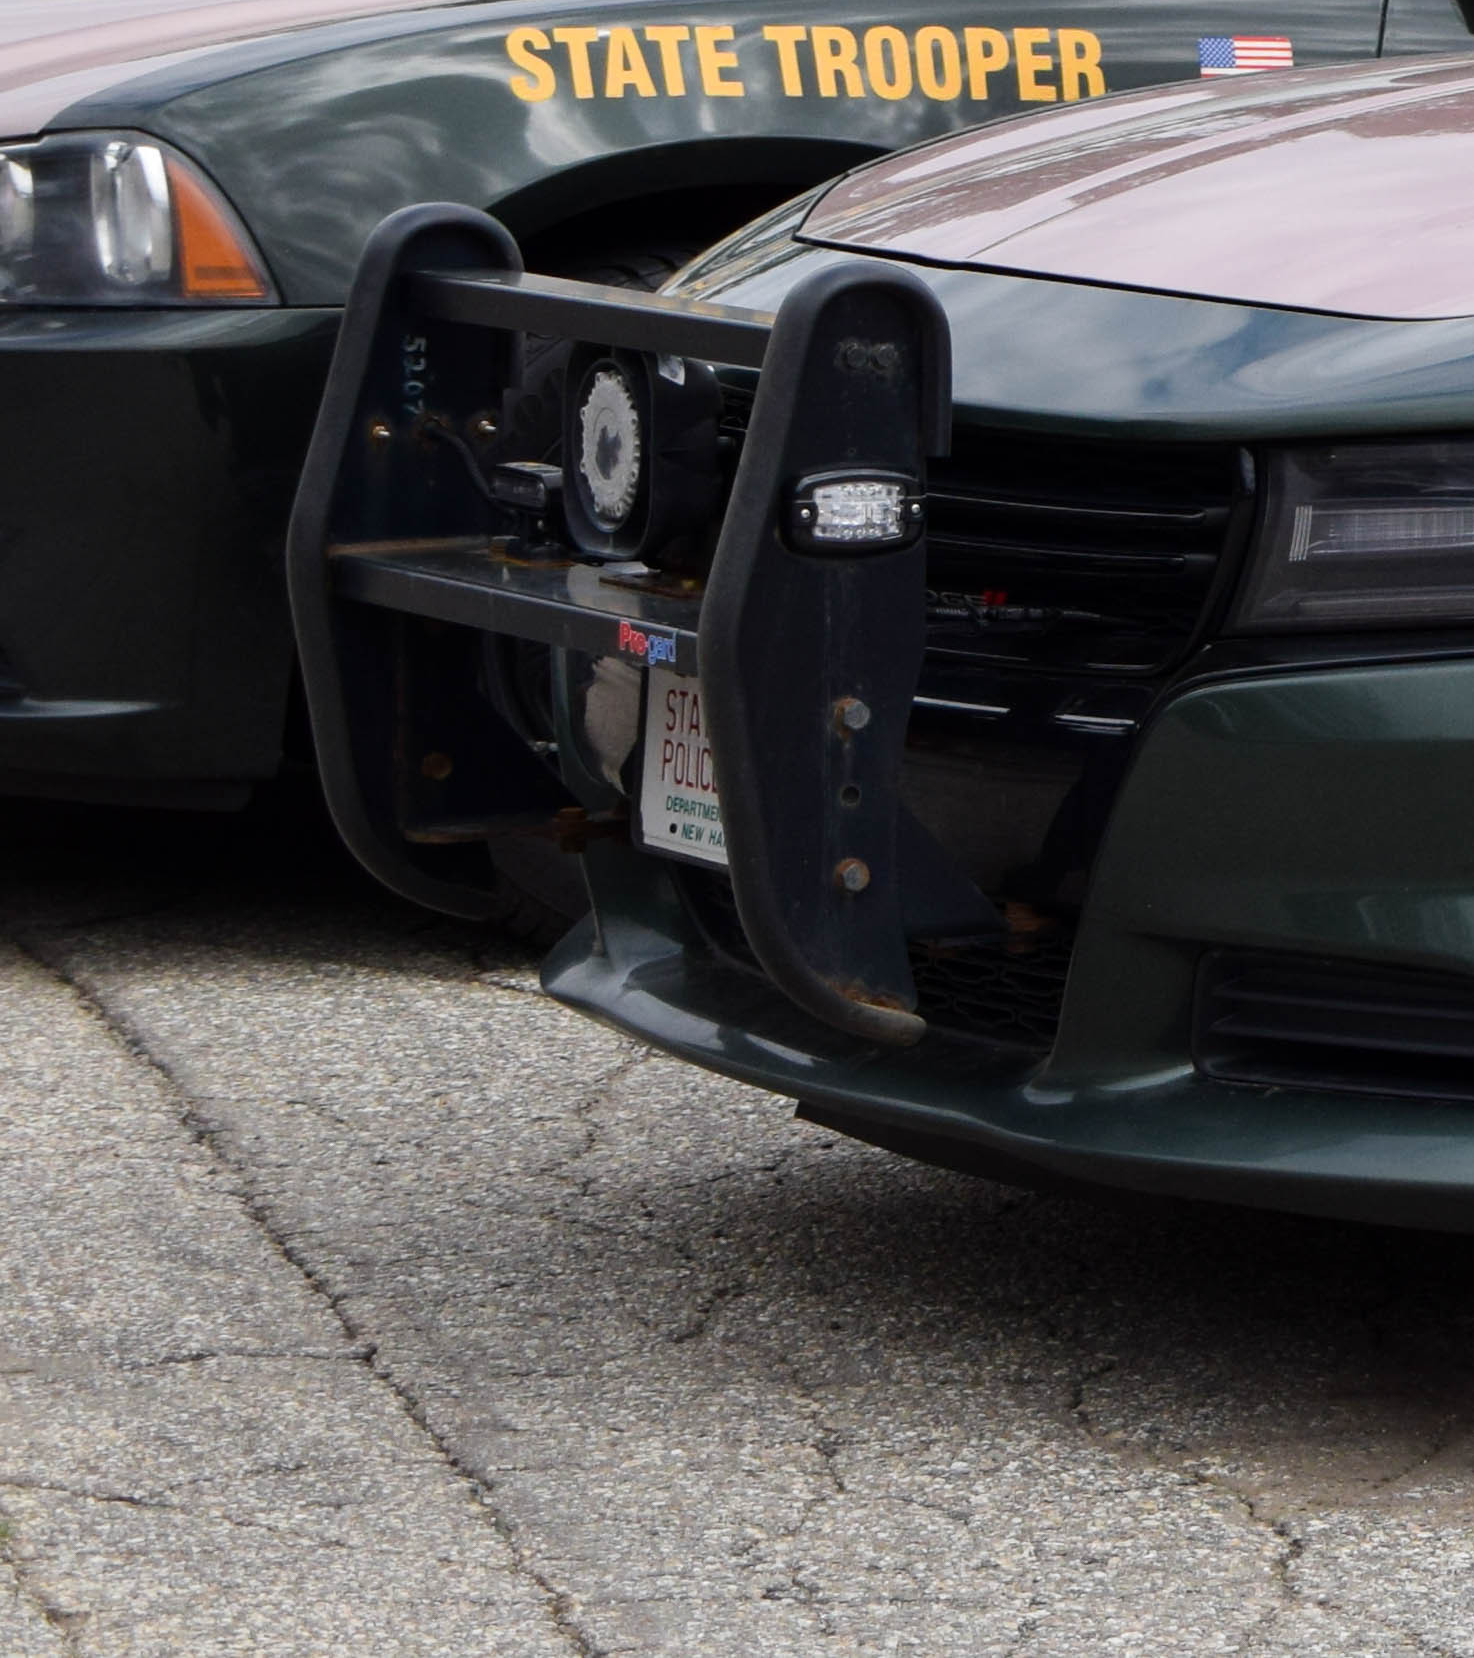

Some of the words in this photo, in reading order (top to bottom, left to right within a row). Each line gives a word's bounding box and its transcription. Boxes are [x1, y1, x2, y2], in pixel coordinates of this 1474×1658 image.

[505, 25, 743, 103] STATE
[762, 24, 1107, 103] TROOPER
[618, 620, 677, 666] Pro-gard
[665, 688, 701, 737] STA
